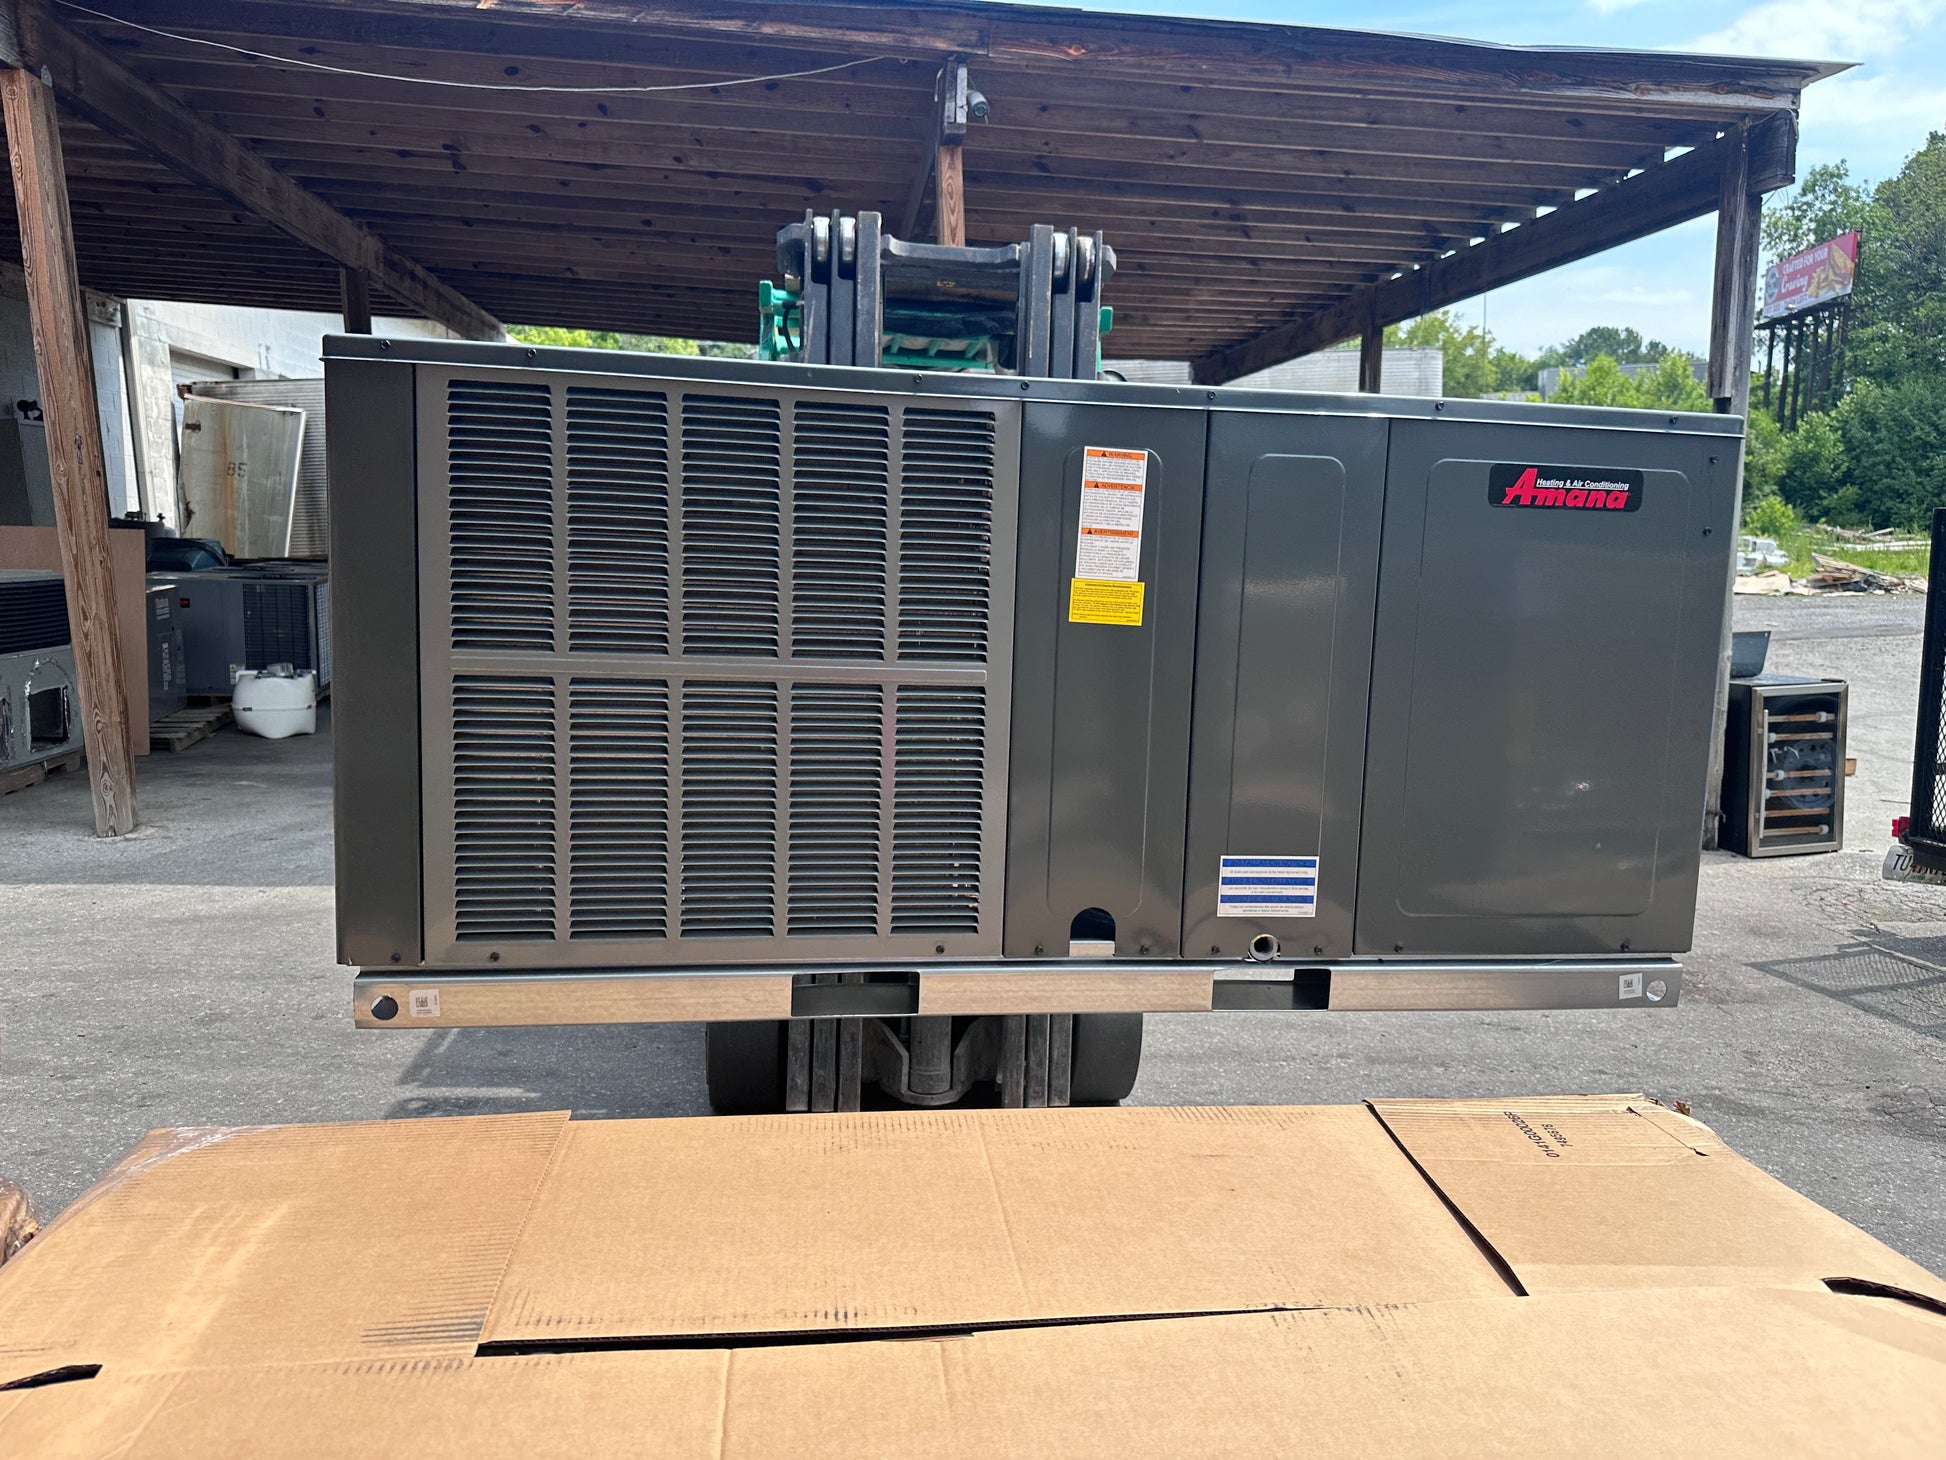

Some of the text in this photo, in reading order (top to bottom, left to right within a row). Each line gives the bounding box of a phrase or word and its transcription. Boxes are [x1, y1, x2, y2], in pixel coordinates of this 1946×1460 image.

[1804, 253, 1814, 267] FOR
[1814, 247, 1829, 261] YOUR
[1781, 274, 1809, 294] Craving
[226, 461, 247, 478] 85
[1502, 467, 1630, 509] Amana
[1536, 478, 1630, 491] Heating & Air Conditioning
